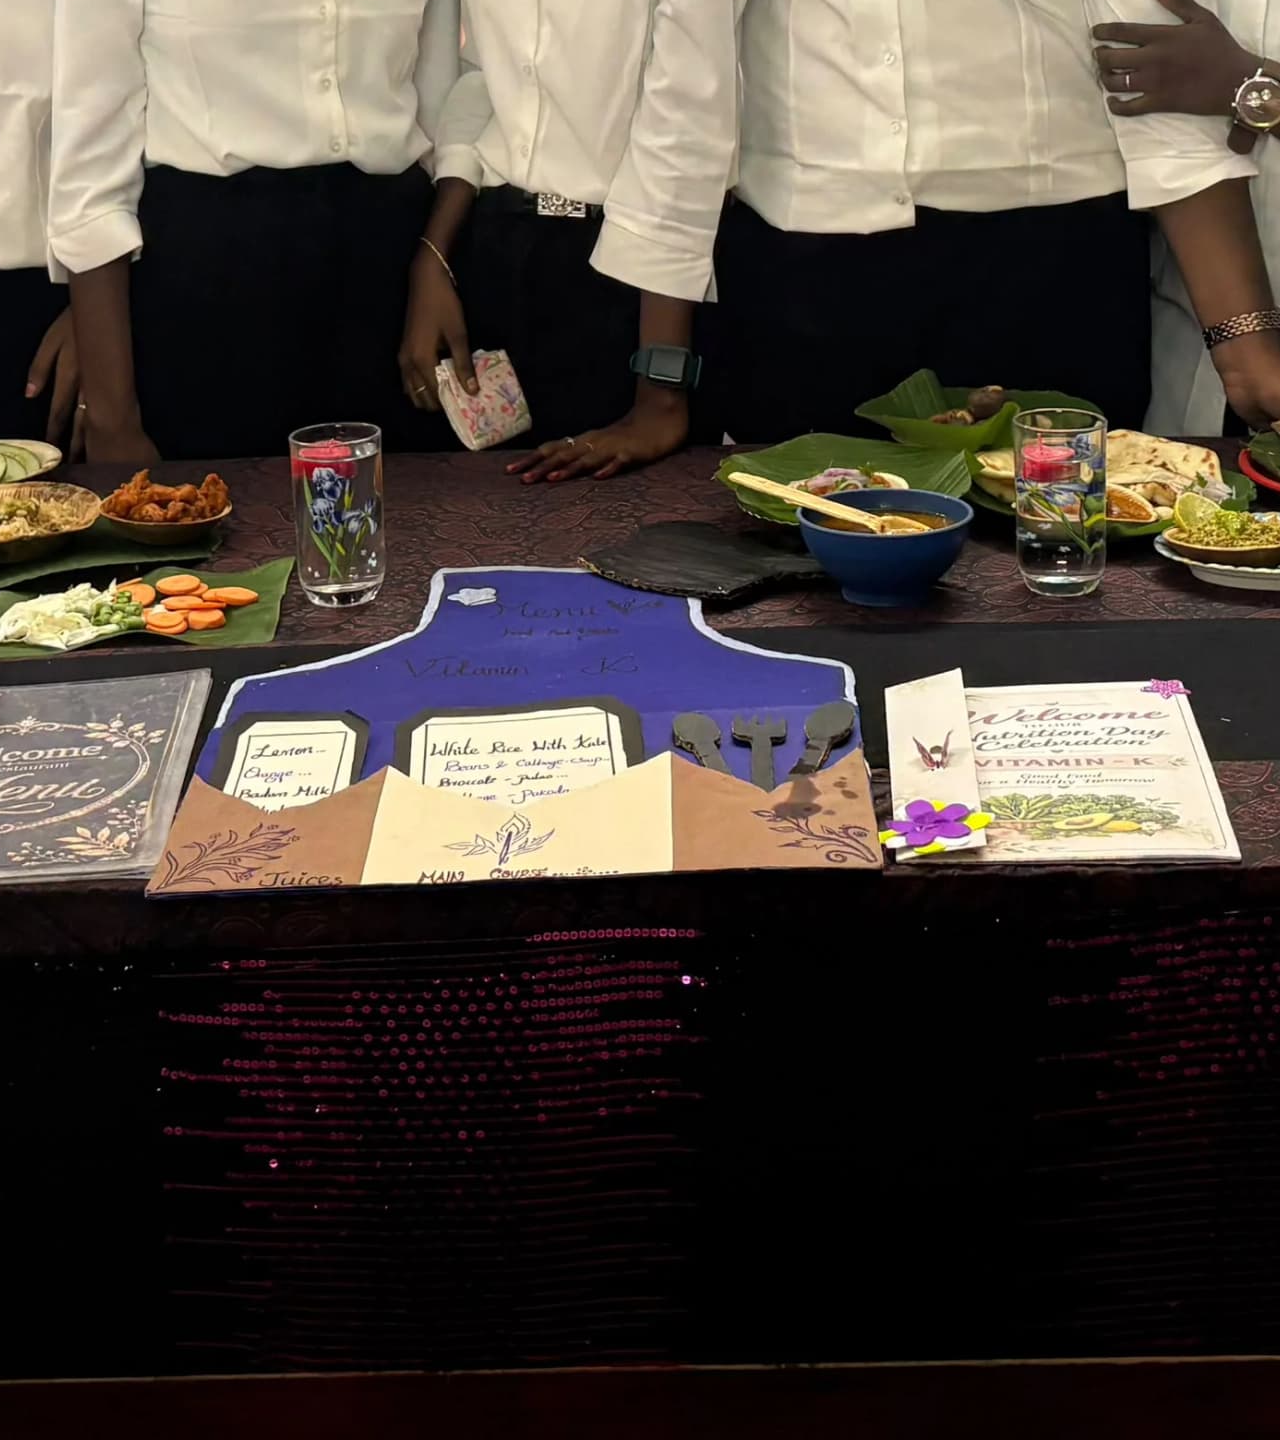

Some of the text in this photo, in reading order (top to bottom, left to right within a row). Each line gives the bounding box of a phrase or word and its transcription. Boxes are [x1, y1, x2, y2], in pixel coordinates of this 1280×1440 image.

[968, 707, 1171, 725] Welcome
[1100, 725, 1172, 740] Day
[430, 737, 480, 756] White
[488, 741, 524, 755] Rice
[532, 737, 567, 752] With
[975, 738, 1152, 753] Celebration
[974, 758, 1105, 768] VITAMIN
[1132, 757, 1156, 767] K
[291, 785, 331, 797] Milk
[259, 870, 344, 888] Juices
[419, 870, 466, 885] MAIN
